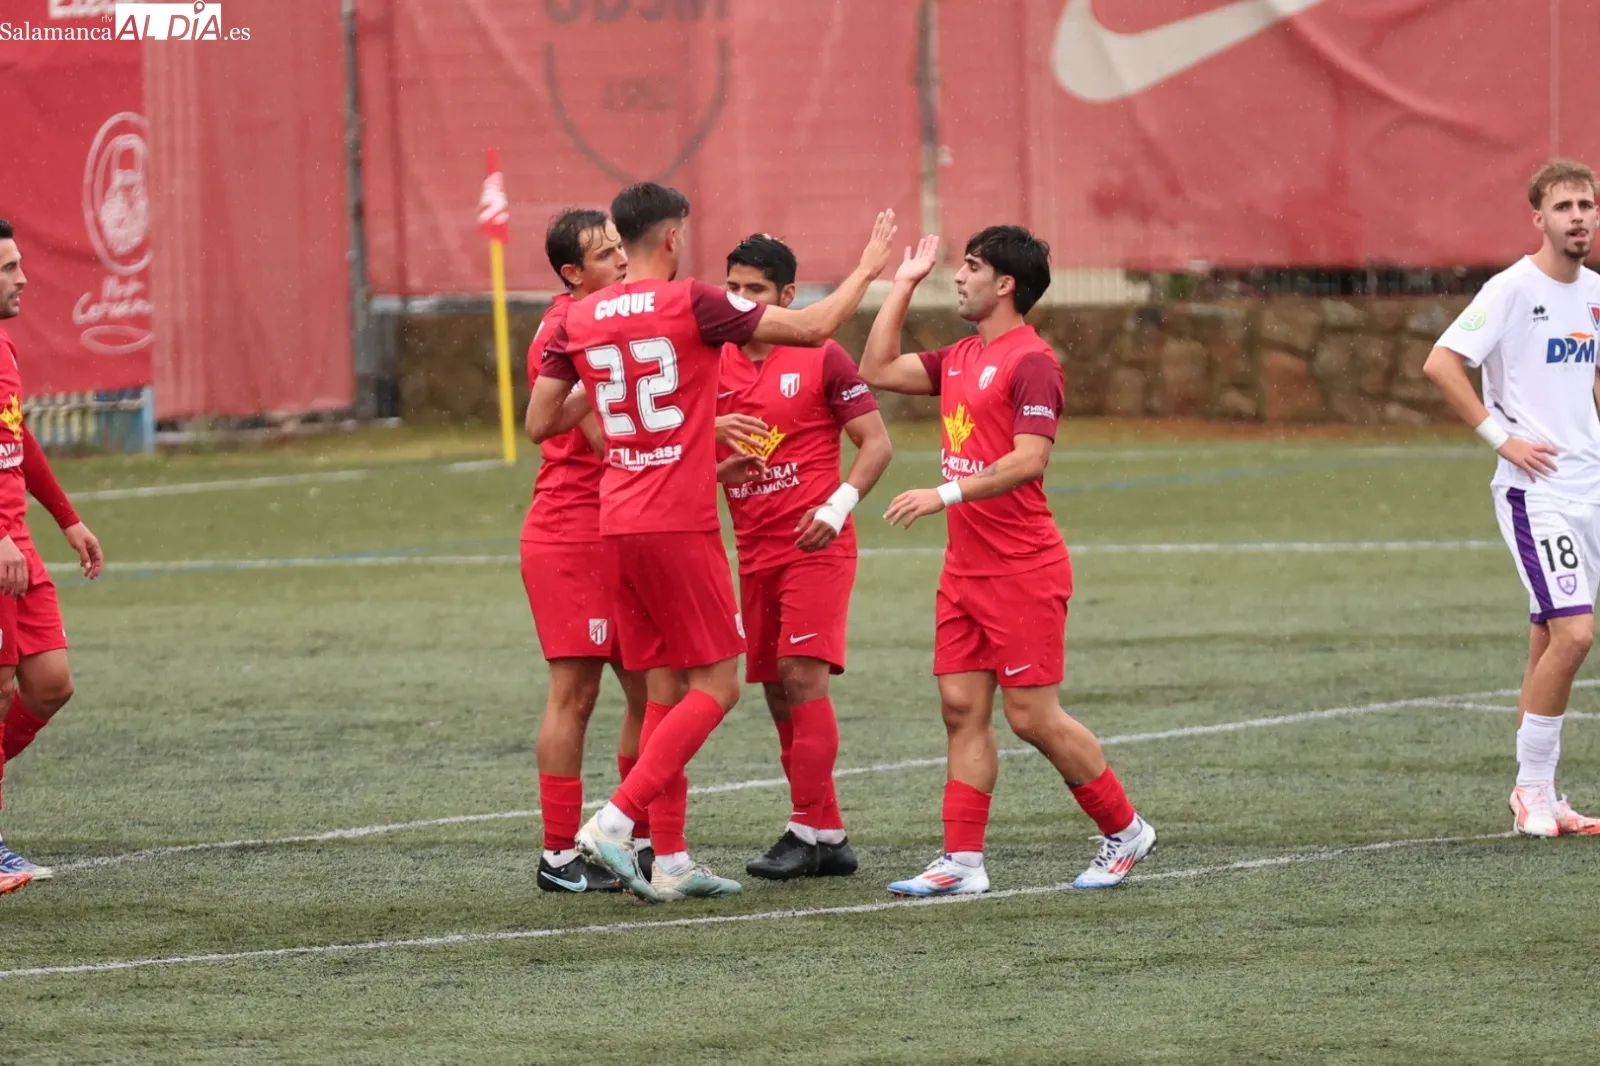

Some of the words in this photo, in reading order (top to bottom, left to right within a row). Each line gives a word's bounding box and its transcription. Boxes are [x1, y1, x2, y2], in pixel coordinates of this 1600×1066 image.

[594, 291, 655, 320] COQUE
[1546, 337, 1595, 364] DPM
[585, 337, 685, 436] 22
[624, 444, 682, 466] Limasa
[1540, 534, 1578, 572] 18
